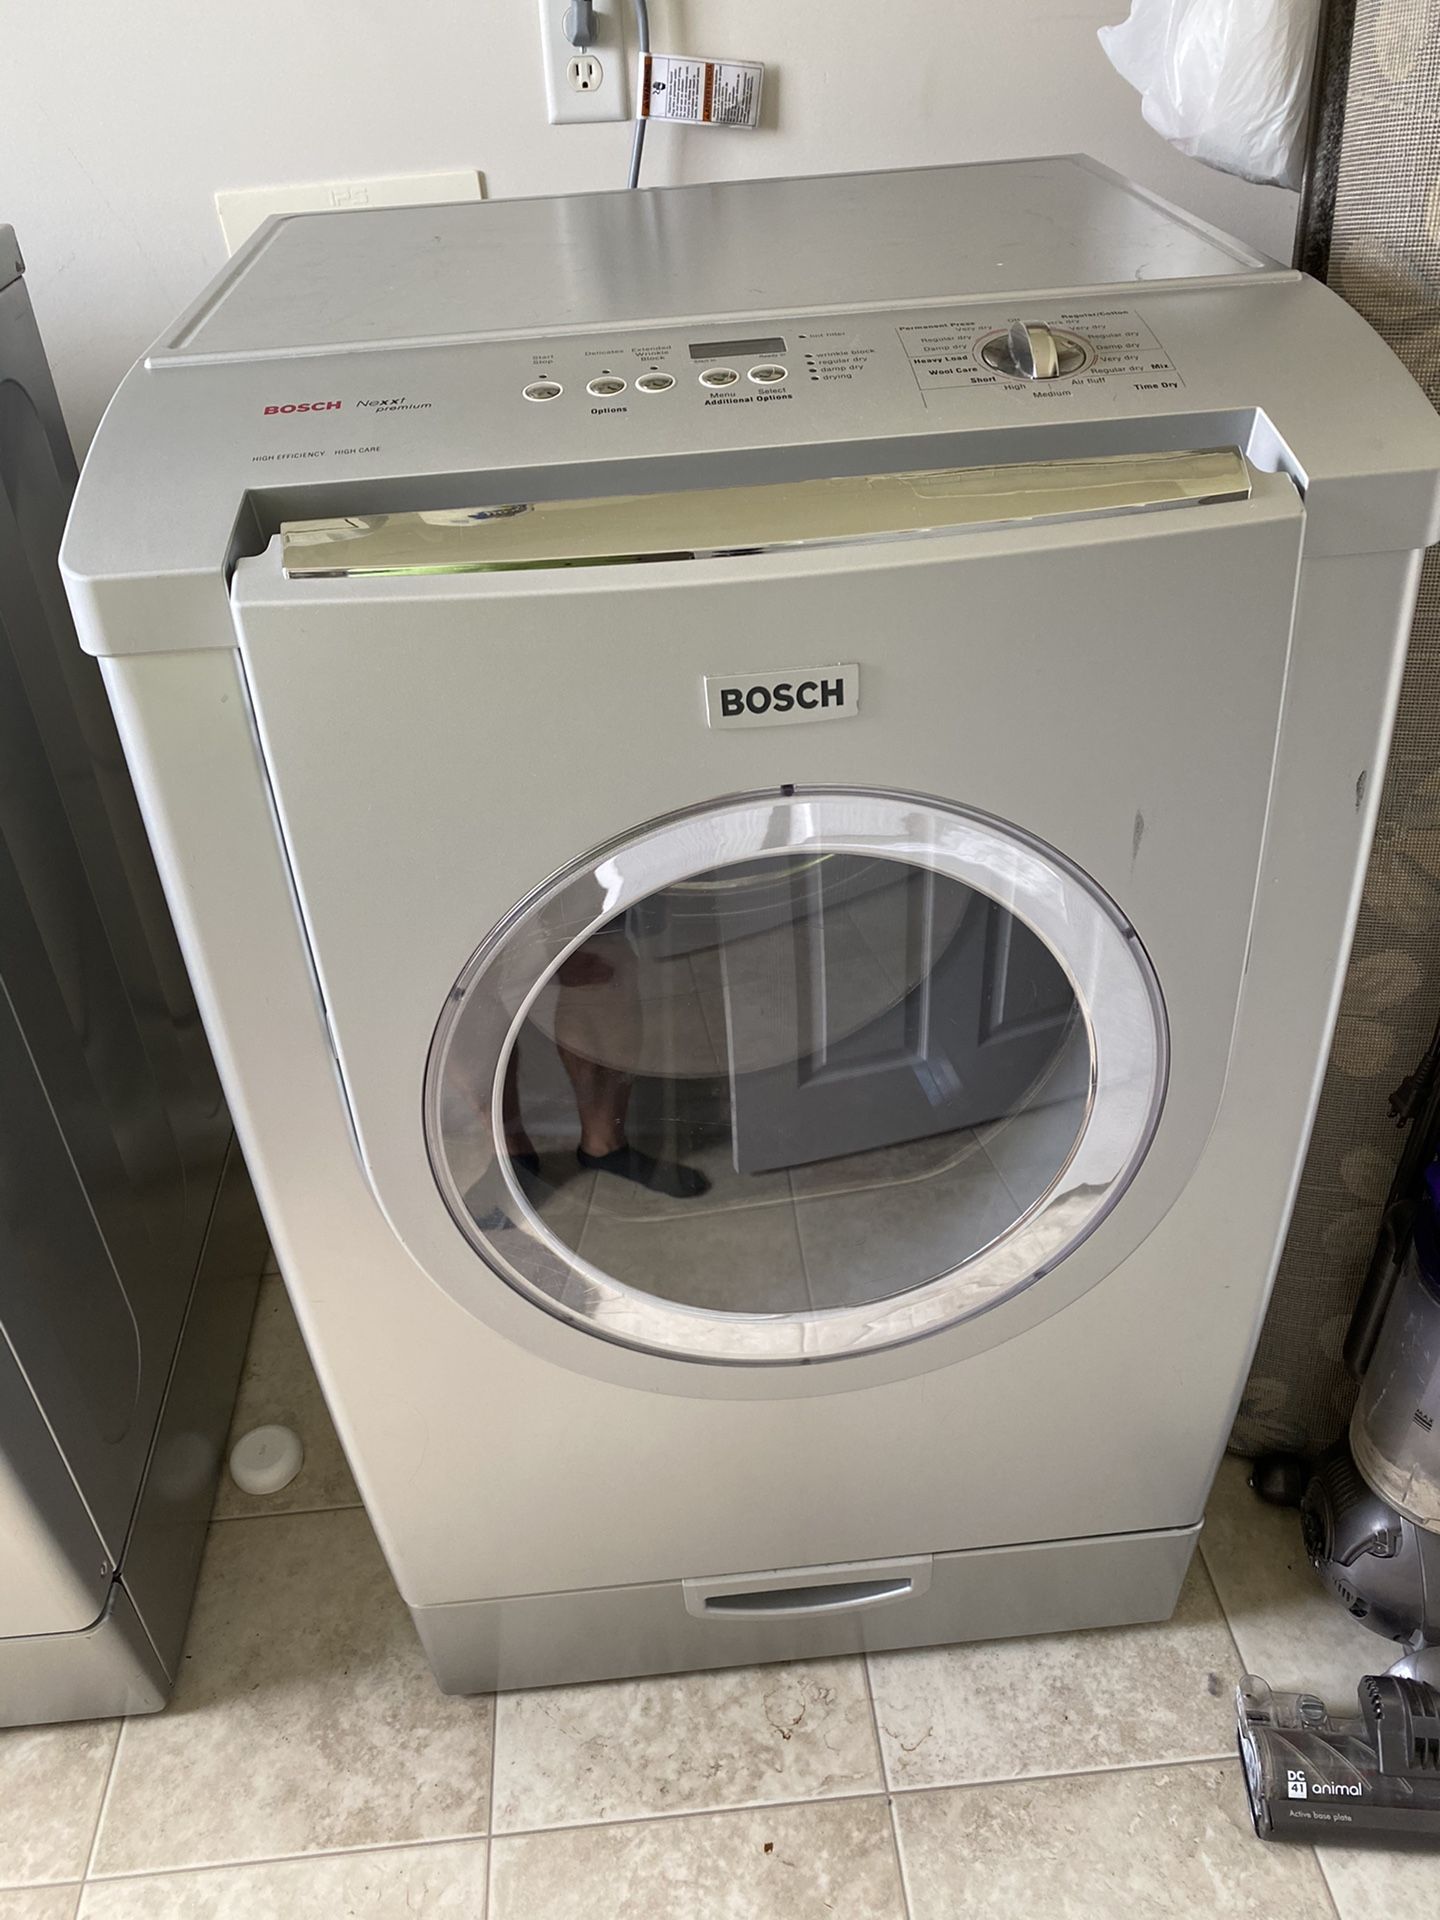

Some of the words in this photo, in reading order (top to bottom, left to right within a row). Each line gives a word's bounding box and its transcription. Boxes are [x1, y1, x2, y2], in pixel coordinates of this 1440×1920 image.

[899, 323, 948, 331] Permanent
[913, 356, 942, 364] Heavy
[928, 368, 954, 376] Wool
[955, 366, 978, 374] Care
[1090, 367, 1126, 375] Regular
[823, 373, 852, 381] drying
[970, 376, 997, 384] Short
[758, 387, 787, 395] Select
[1133, 383, 1159, 391] Time
[1160, 381, 1178, 389] Dry
[704, 396, 753, 406] Additional
[756, 393, 793, 402] Options
[1032, 390, 1072, 399] Medium
[263, 400, 342, 416] BOSCH
[375, 402, 432, 414] premium
[591, 406, 628, 415] Options
[276, 450, 326, 460] EFFICIENCY
[334, 448, 357, 456] HIGH
[358, 446, 381, 454] CARE
[720, 678, 844, 717] BOSCH
[1287, 1770, 1306, 1781] DC
[1290, 1784, 1305, 1794] 41
[1311, 1781, 1363, 1797] animal
[1289, 1809, 1312, 1819] Active
[1312, 1810, 1331, 1820] base
[1333, 1812, 1352, 1822] plate
